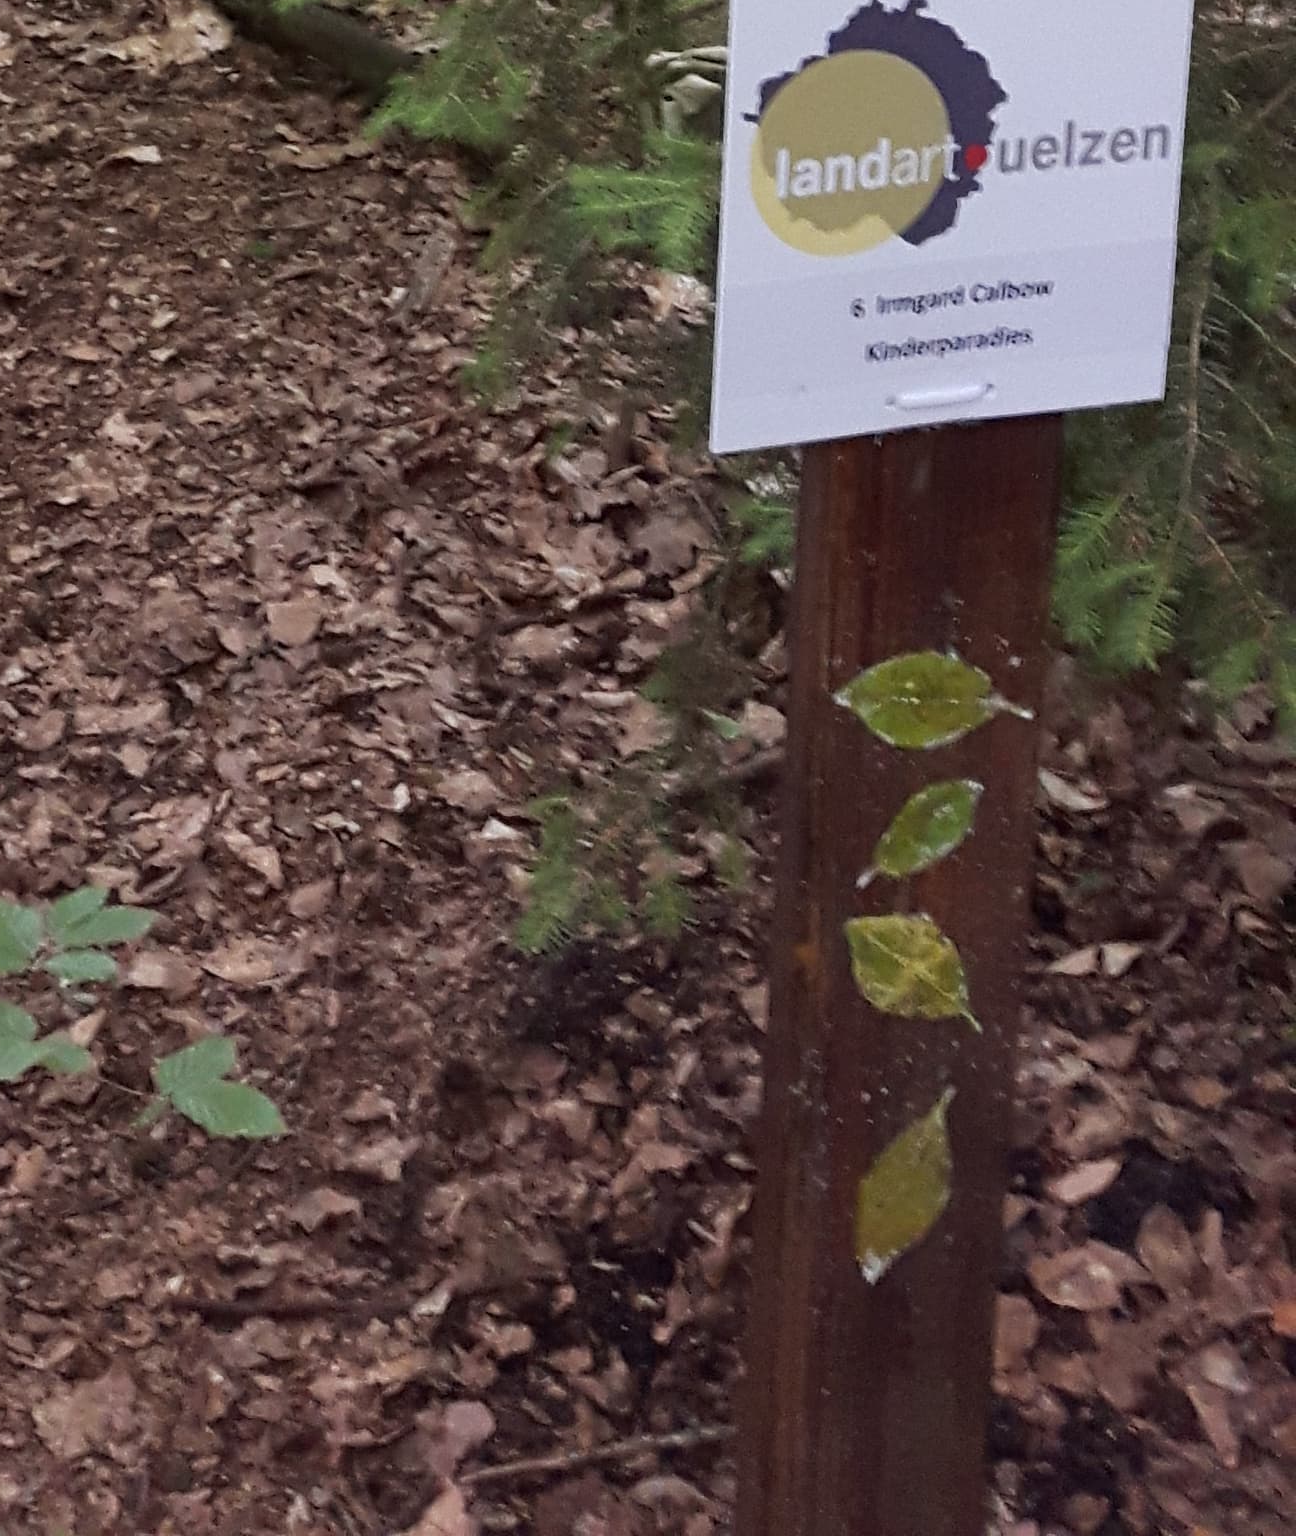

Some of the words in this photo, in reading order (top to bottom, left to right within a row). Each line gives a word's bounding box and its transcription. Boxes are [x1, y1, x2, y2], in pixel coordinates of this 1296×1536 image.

[774, 133, 960, 198] landart
[997, 119, 1171, 174] uelzen
[876, 285, 966, 315] Irmgard
[865, 326, 1034, 362] Kinderparadies
